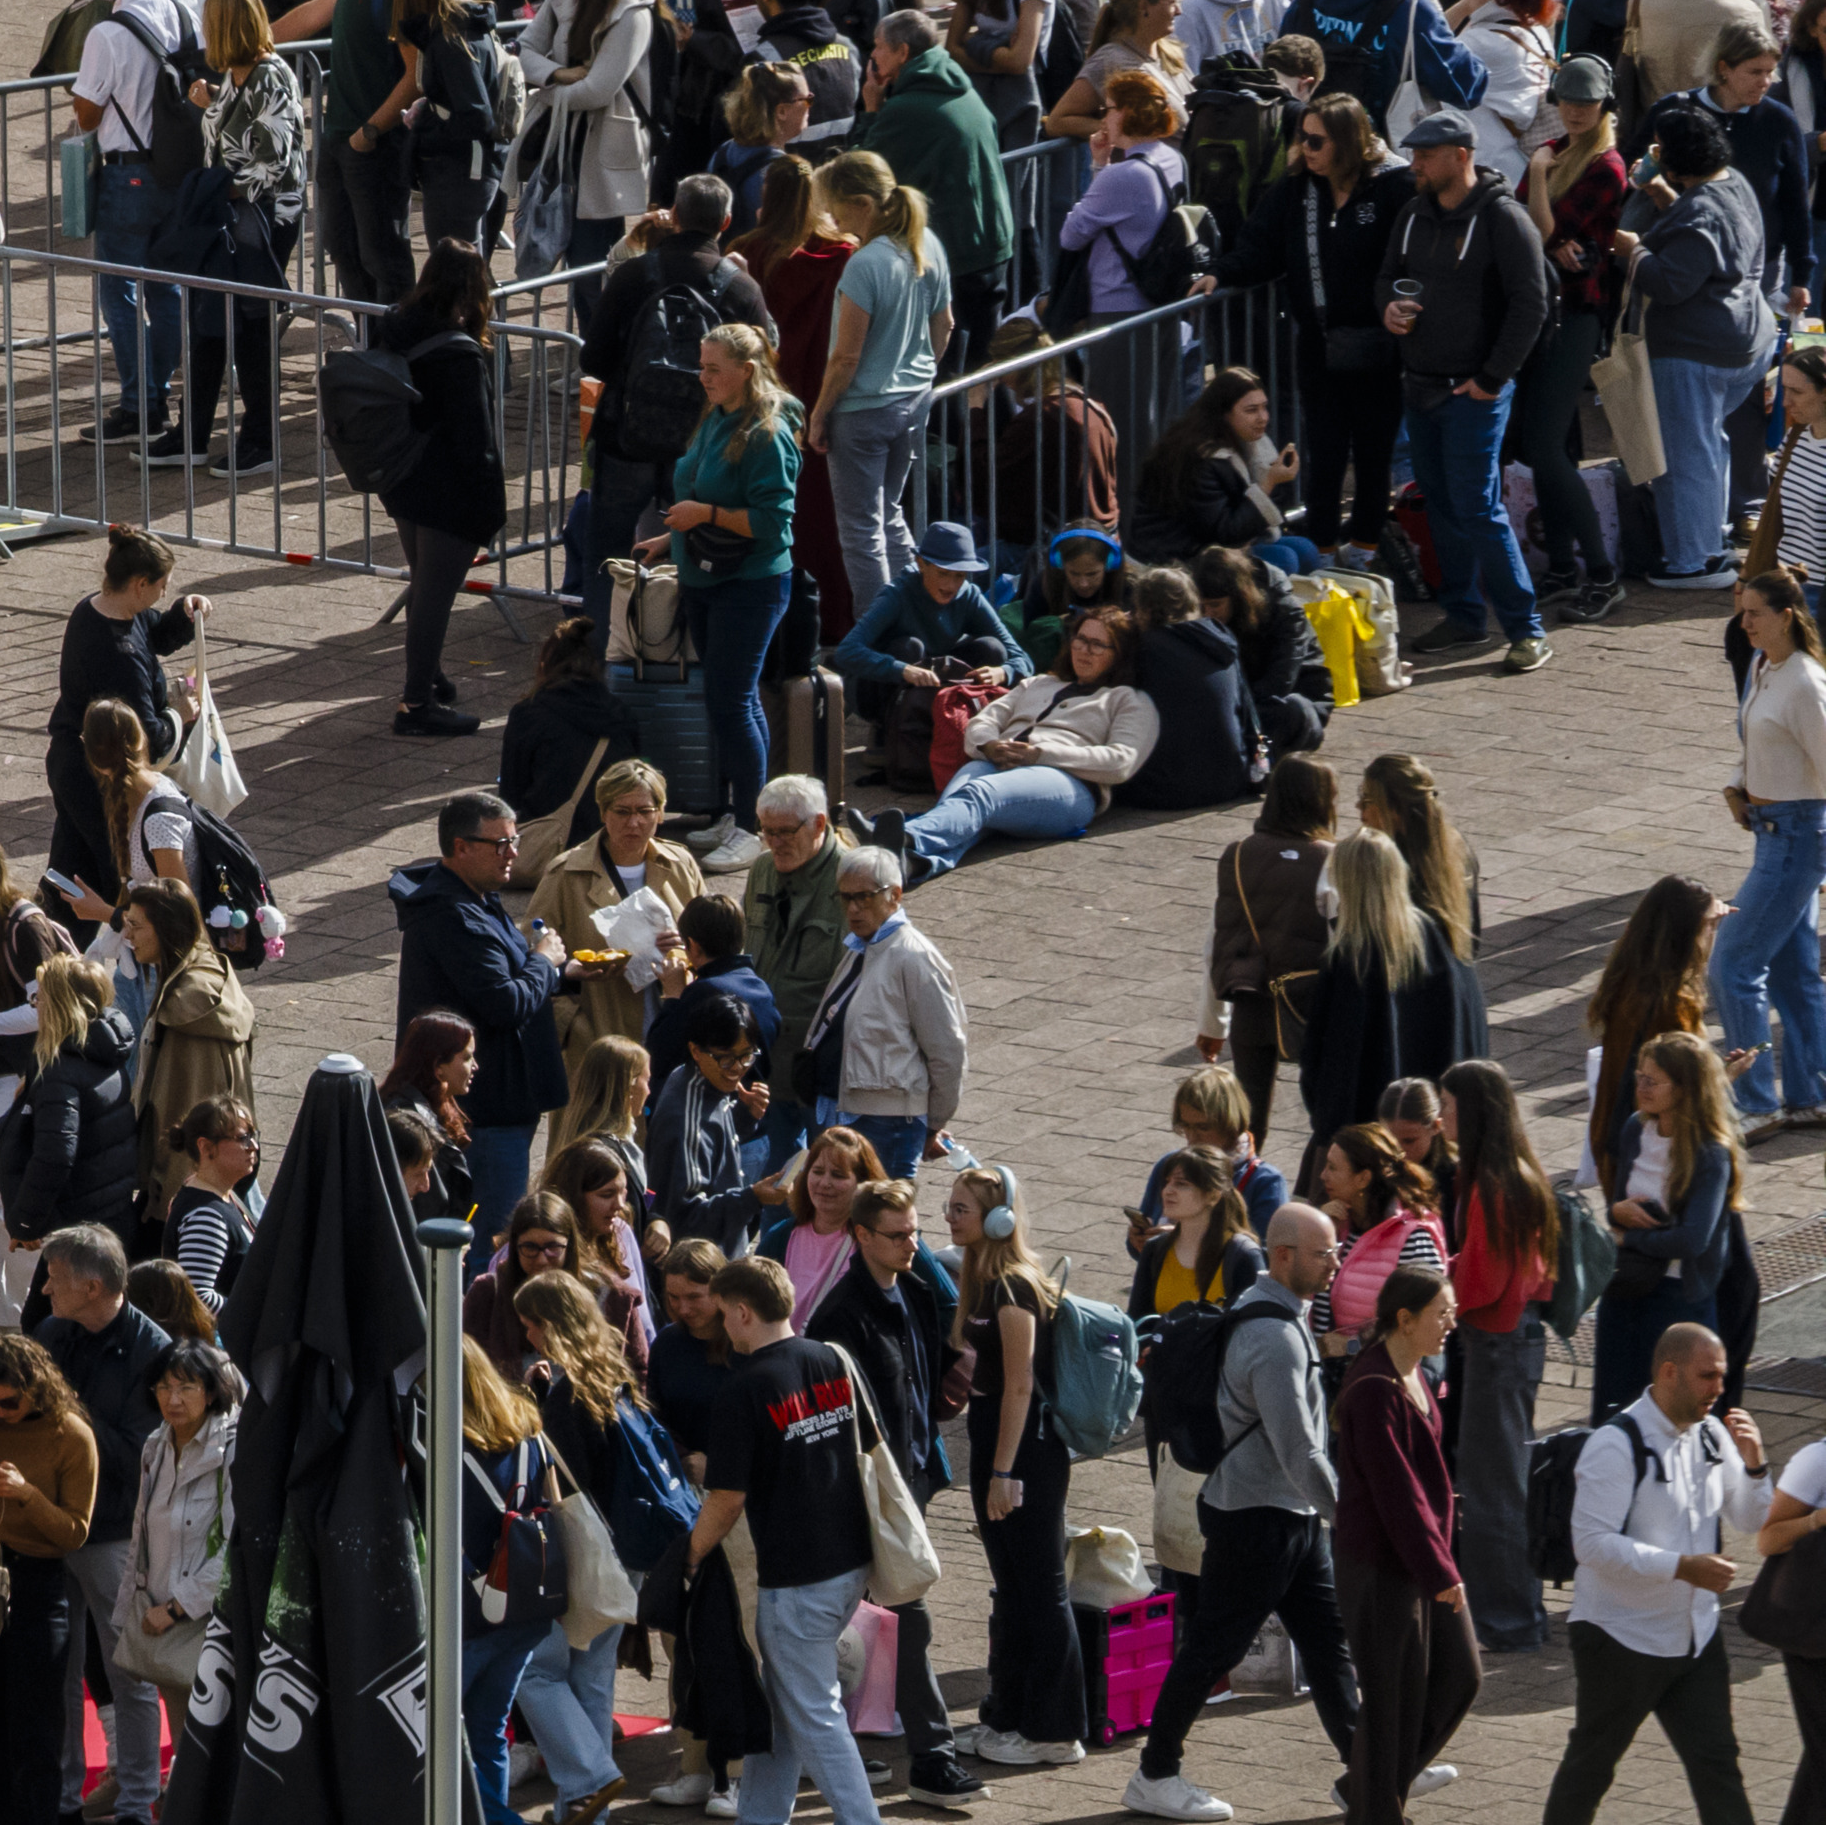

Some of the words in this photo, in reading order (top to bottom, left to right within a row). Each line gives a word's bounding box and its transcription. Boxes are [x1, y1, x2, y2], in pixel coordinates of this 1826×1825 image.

[767, 1387, 815, 1432] WILL
[805, 1433, 821, 1444] NEW
[821, 1426, 840, 1438] YORK
